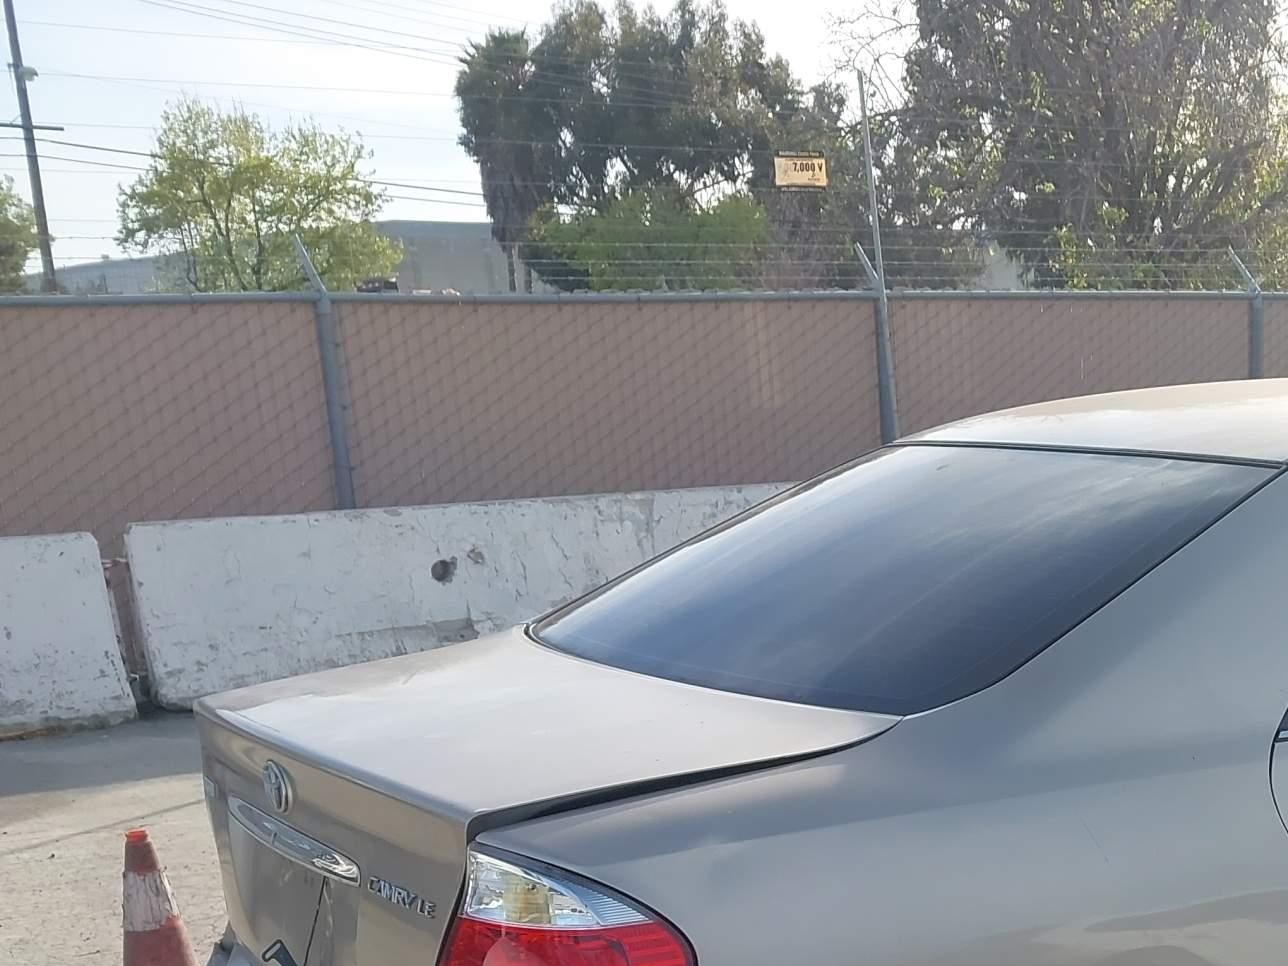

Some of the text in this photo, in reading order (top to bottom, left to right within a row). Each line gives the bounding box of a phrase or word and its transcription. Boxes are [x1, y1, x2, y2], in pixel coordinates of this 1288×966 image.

[792, 162, 824, 173] 7,000 V
[367, 876, 436, 919] CAMRY LE
